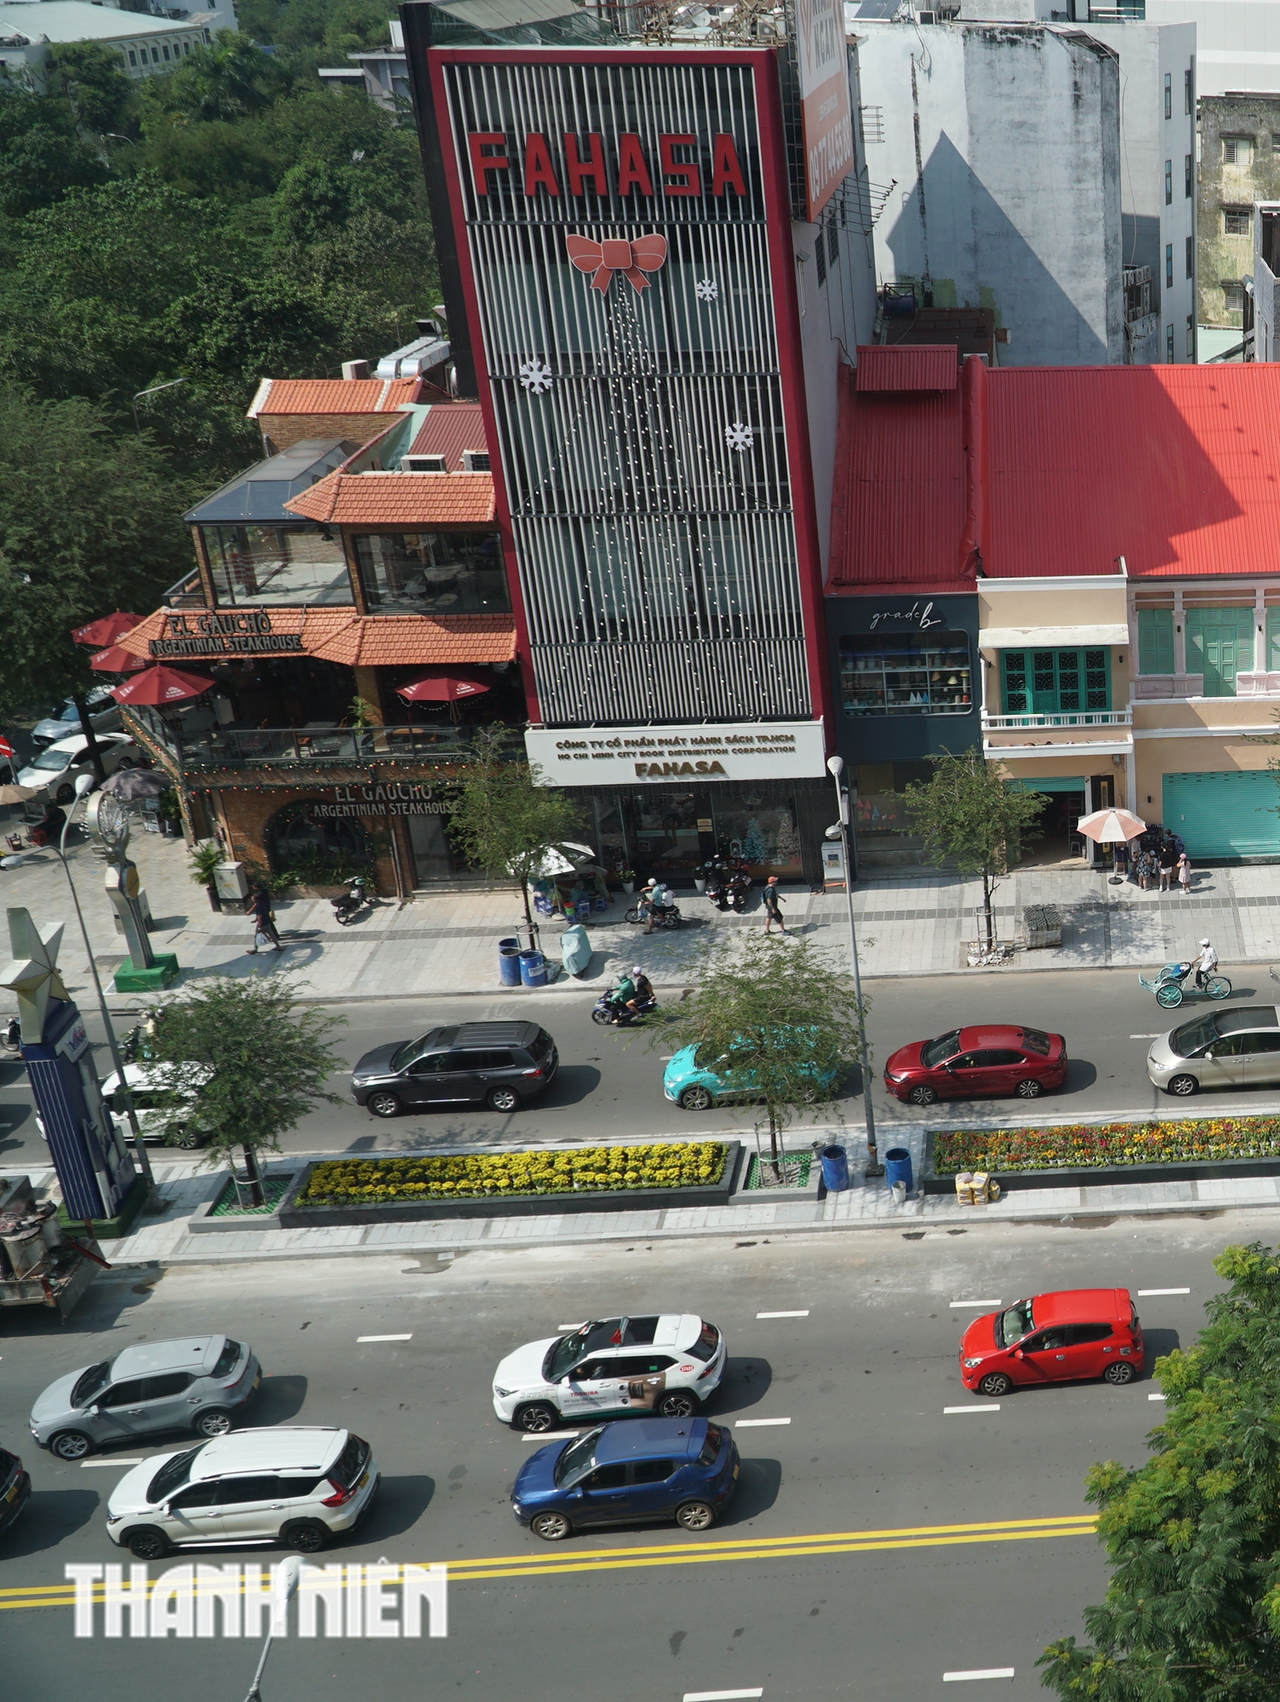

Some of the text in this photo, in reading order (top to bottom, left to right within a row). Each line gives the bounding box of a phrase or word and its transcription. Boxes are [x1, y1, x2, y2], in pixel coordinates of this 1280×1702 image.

[468, 132, 747, 196] FAHASA
[168, 613, 271, 636] EL GAUCHO
[149, 635, 301, 654] ARGENTINIAN STEAKHOUSE
[556, 734, 795, 750] CÔNG TY CỔ PHẦN PHÁT HÀNH SÁCH TP.HCM
[573, 752, 588, 760] CHI
[617, 750, 637, 758] CITY
[639, 750, 665, 758] BOOK
[668, 748, 729, 756] DISTRIBUTION
[732, 745, 796, 754] CORPORATION
[634, 760, 726, 777] FAHASA
[335, 785, 433, 801] EL GAUCHO
[314, 801, 460, 817] ARGENTINIAN STEAKHOUSE
